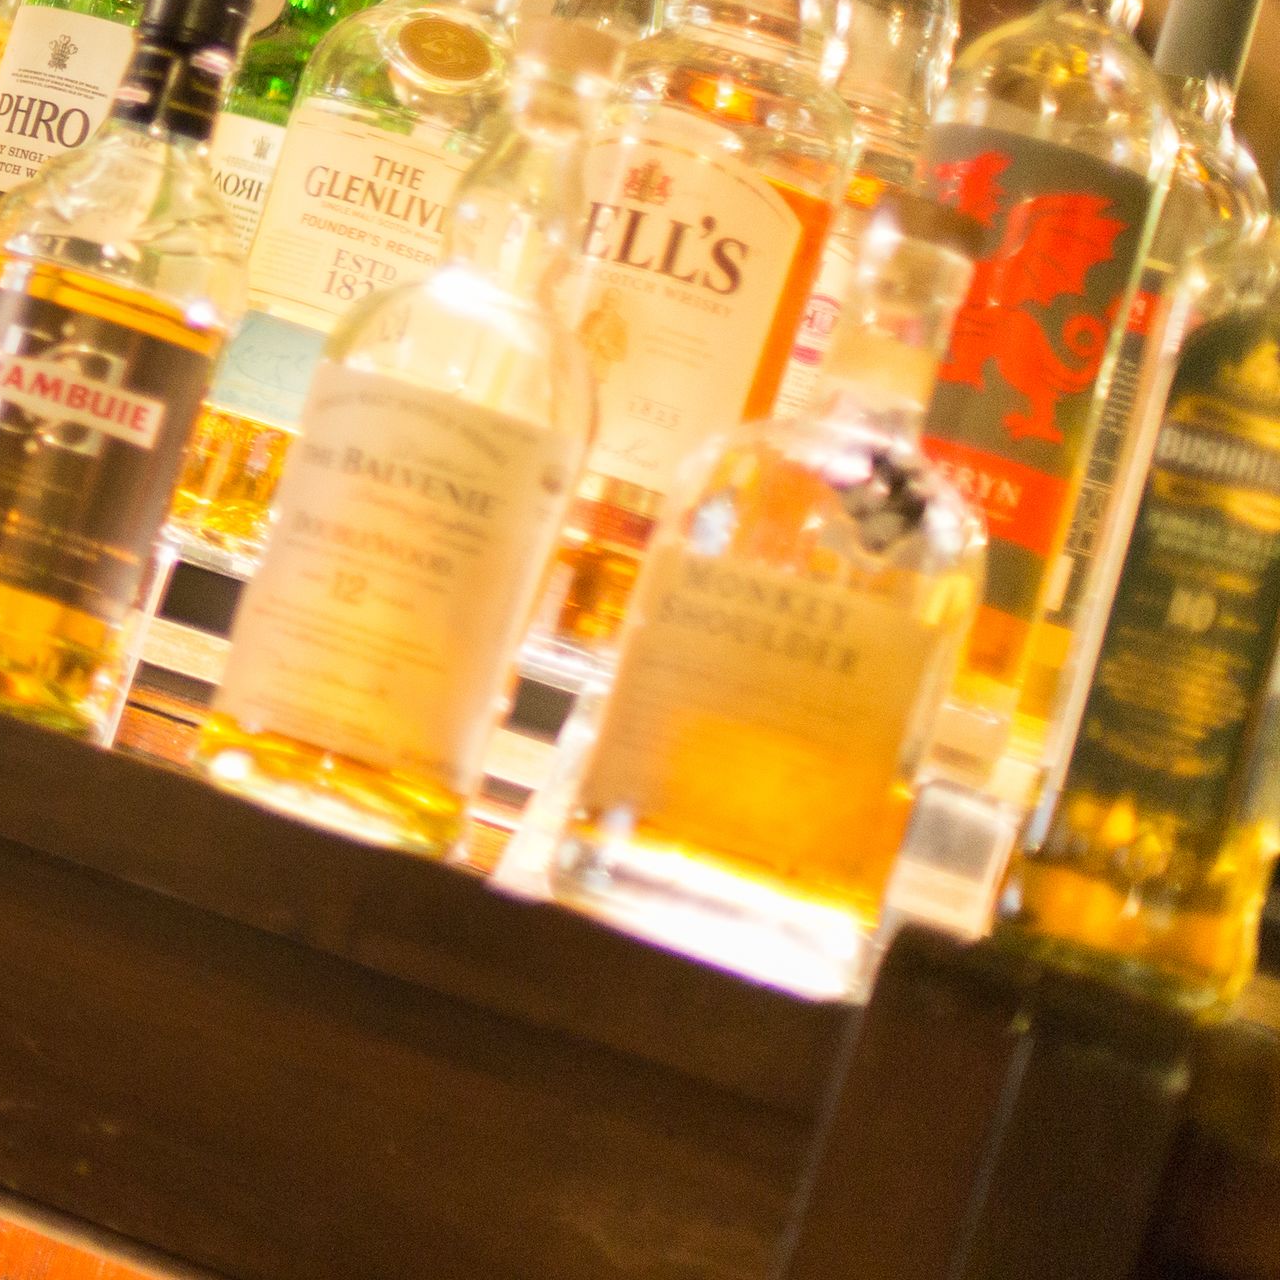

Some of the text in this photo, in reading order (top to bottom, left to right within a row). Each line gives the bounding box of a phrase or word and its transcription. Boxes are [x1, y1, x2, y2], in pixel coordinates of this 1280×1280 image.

[7, 145, 52, 164] SINGL
[372, 154, 426, 192] THE
[300, 213, 443, 268] FOUNDER'S RESERV
[581, 201, 750, 296] ELL'S
[321, 269, 375, 304] 182
